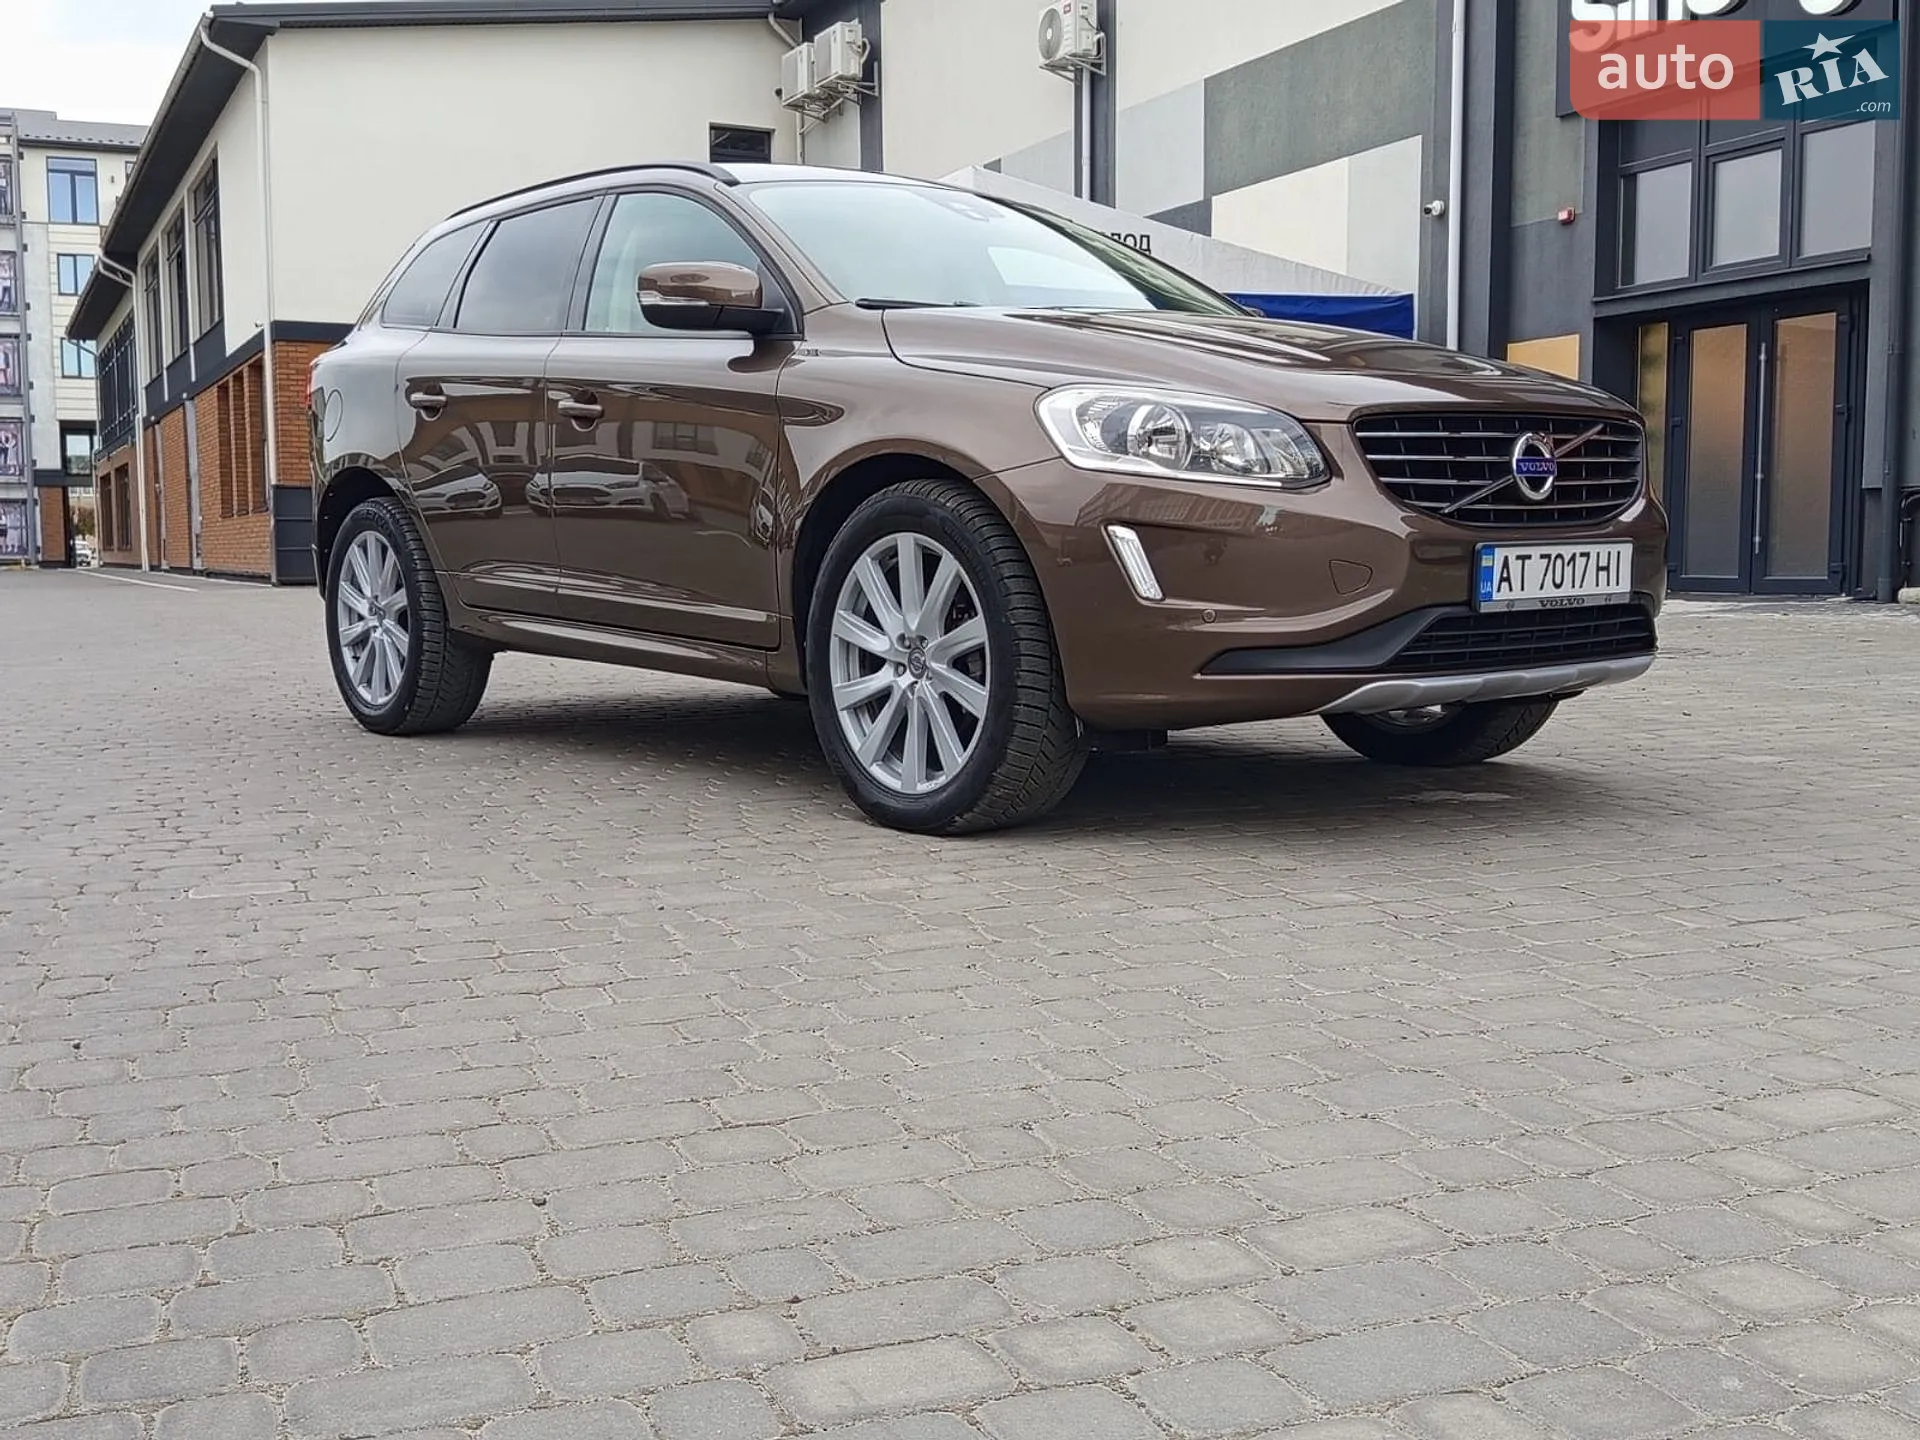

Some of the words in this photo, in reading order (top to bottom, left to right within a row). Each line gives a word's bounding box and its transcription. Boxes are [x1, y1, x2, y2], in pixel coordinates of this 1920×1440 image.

[1518, 461, 1555, 472] VOLVO
[1496, 553, 1532, 593] AT
[1538, 551, 1591, 591] 7017
[1595, 550, 1622, 589] HI
[1480, 581, 1492, 594] UA
[1539, 597, 1586, 608] VOLVO
